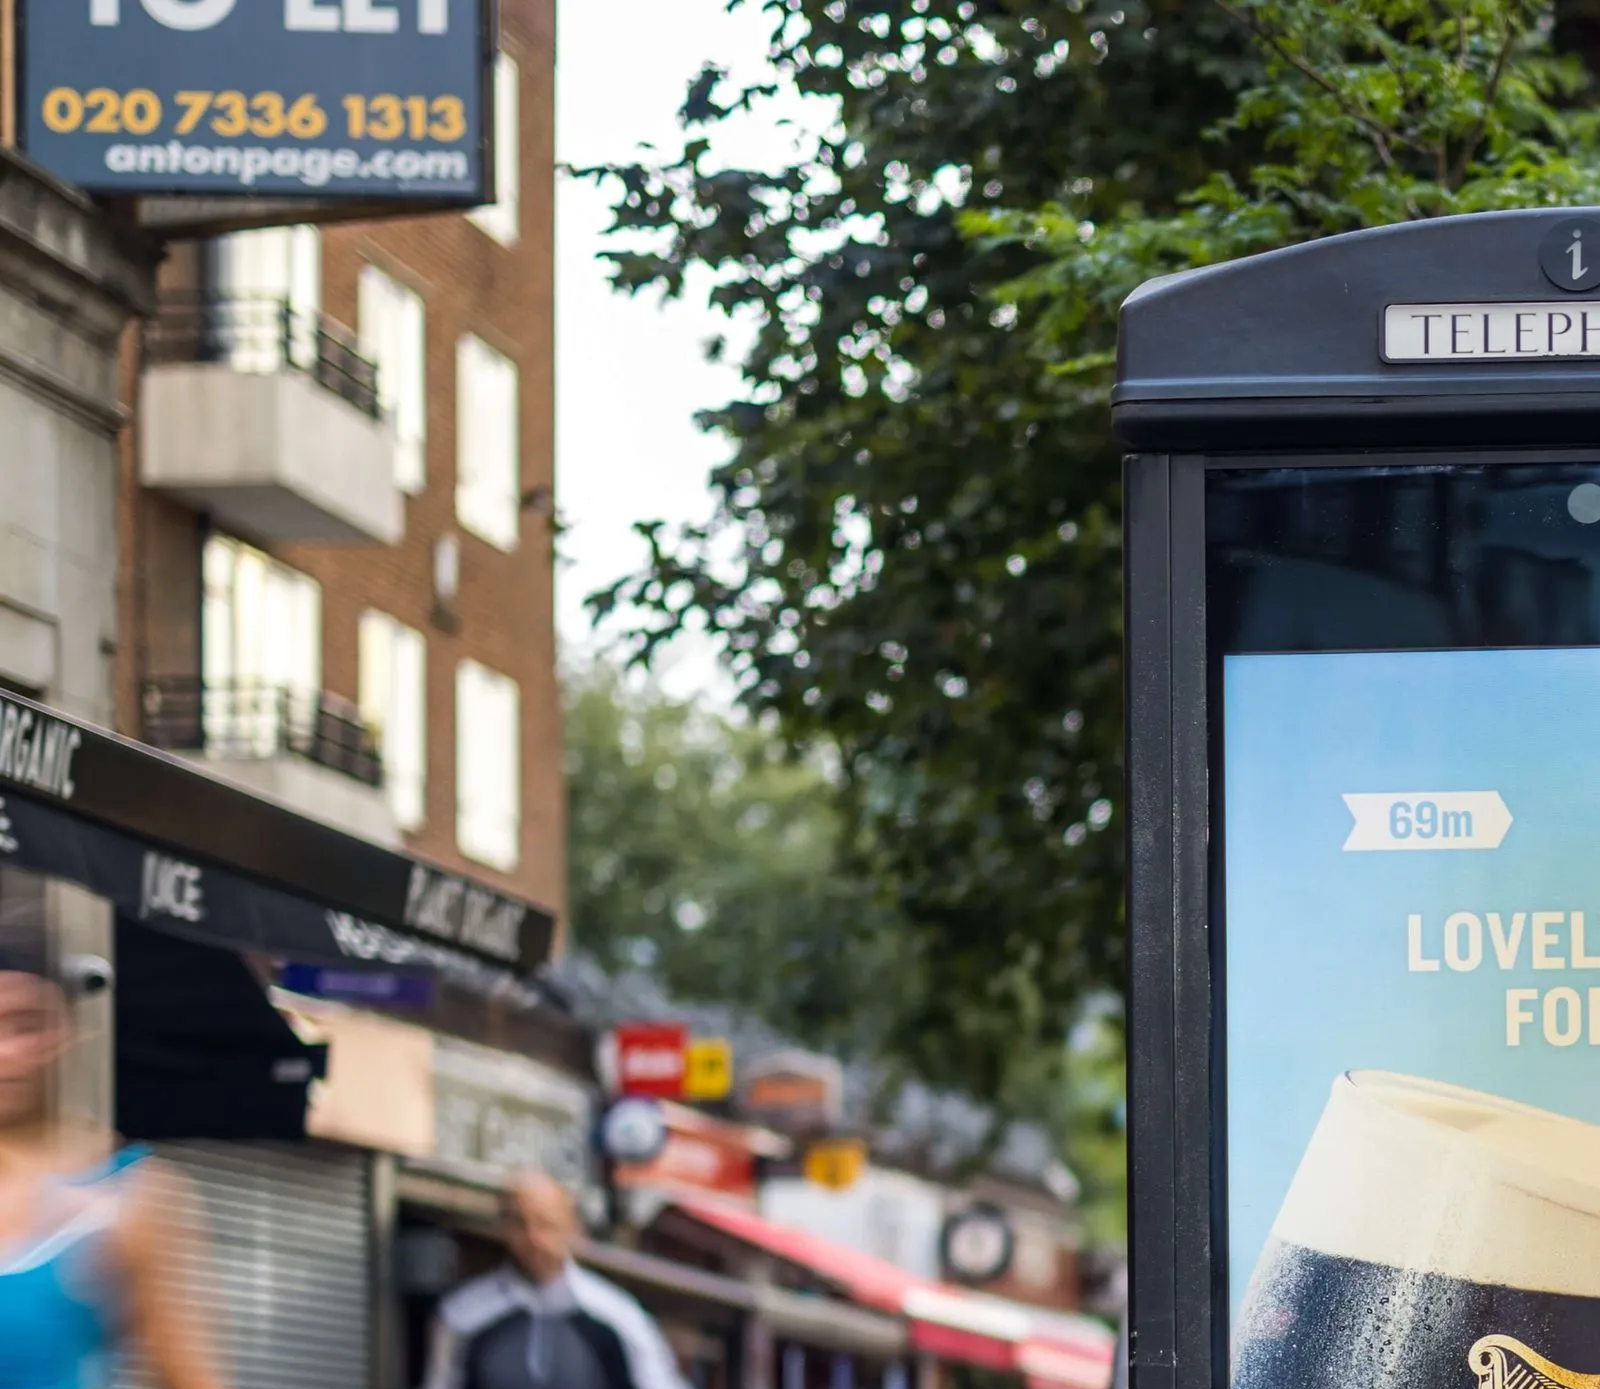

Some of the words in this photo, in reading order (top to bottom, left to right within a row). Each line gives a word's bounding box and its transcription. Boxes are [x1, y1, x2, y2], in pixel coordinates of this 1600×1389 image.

[42, 86, 161, 134] 020
[174, 90, 326, 140] 7336
[341, 95, 467, 142] 1313
[105, 140, 468, 185] antonpage.com
[1389, 801, 1473, 839] 69m
